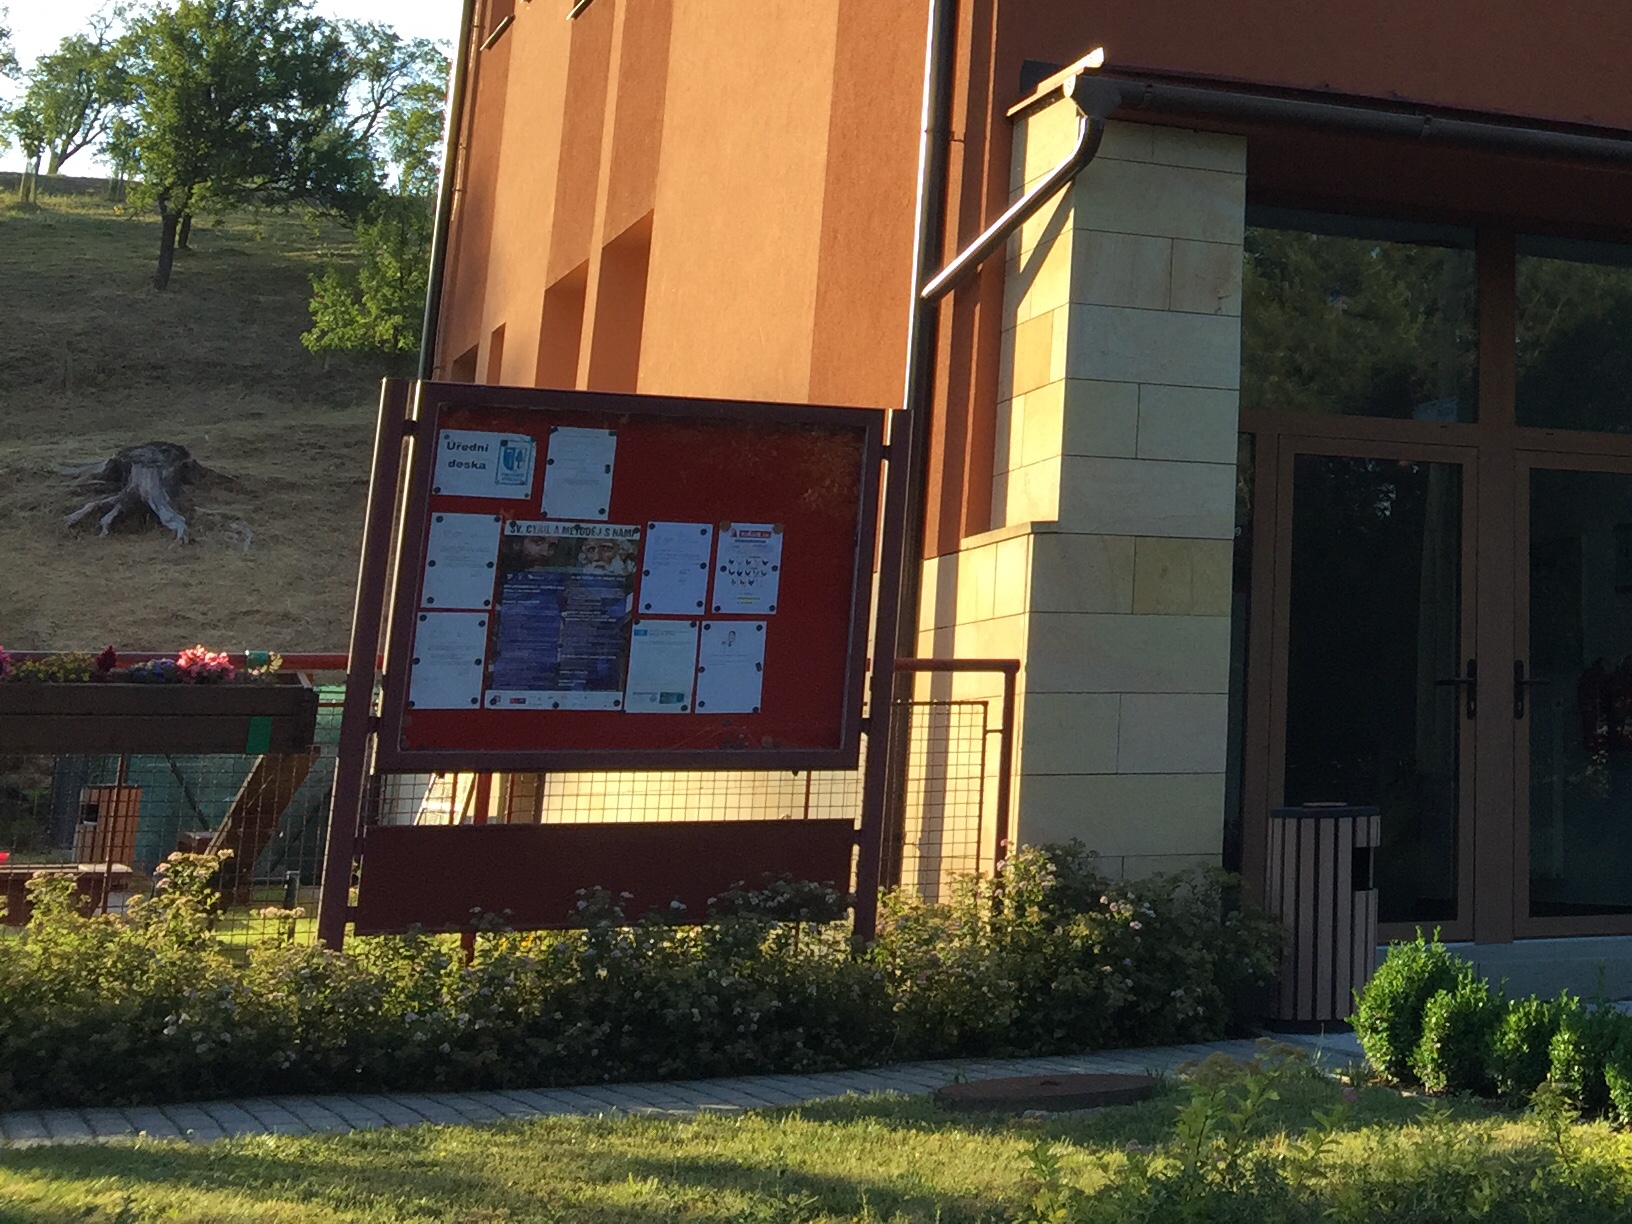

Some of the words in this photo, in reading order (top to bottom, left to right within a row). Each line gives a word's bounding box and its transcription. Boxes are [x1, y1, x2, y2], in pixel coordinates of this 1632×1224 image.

[448, 459, 486, 470] deska
[553, 525, 560, 534] A
[603, 527, 611, 537] S
